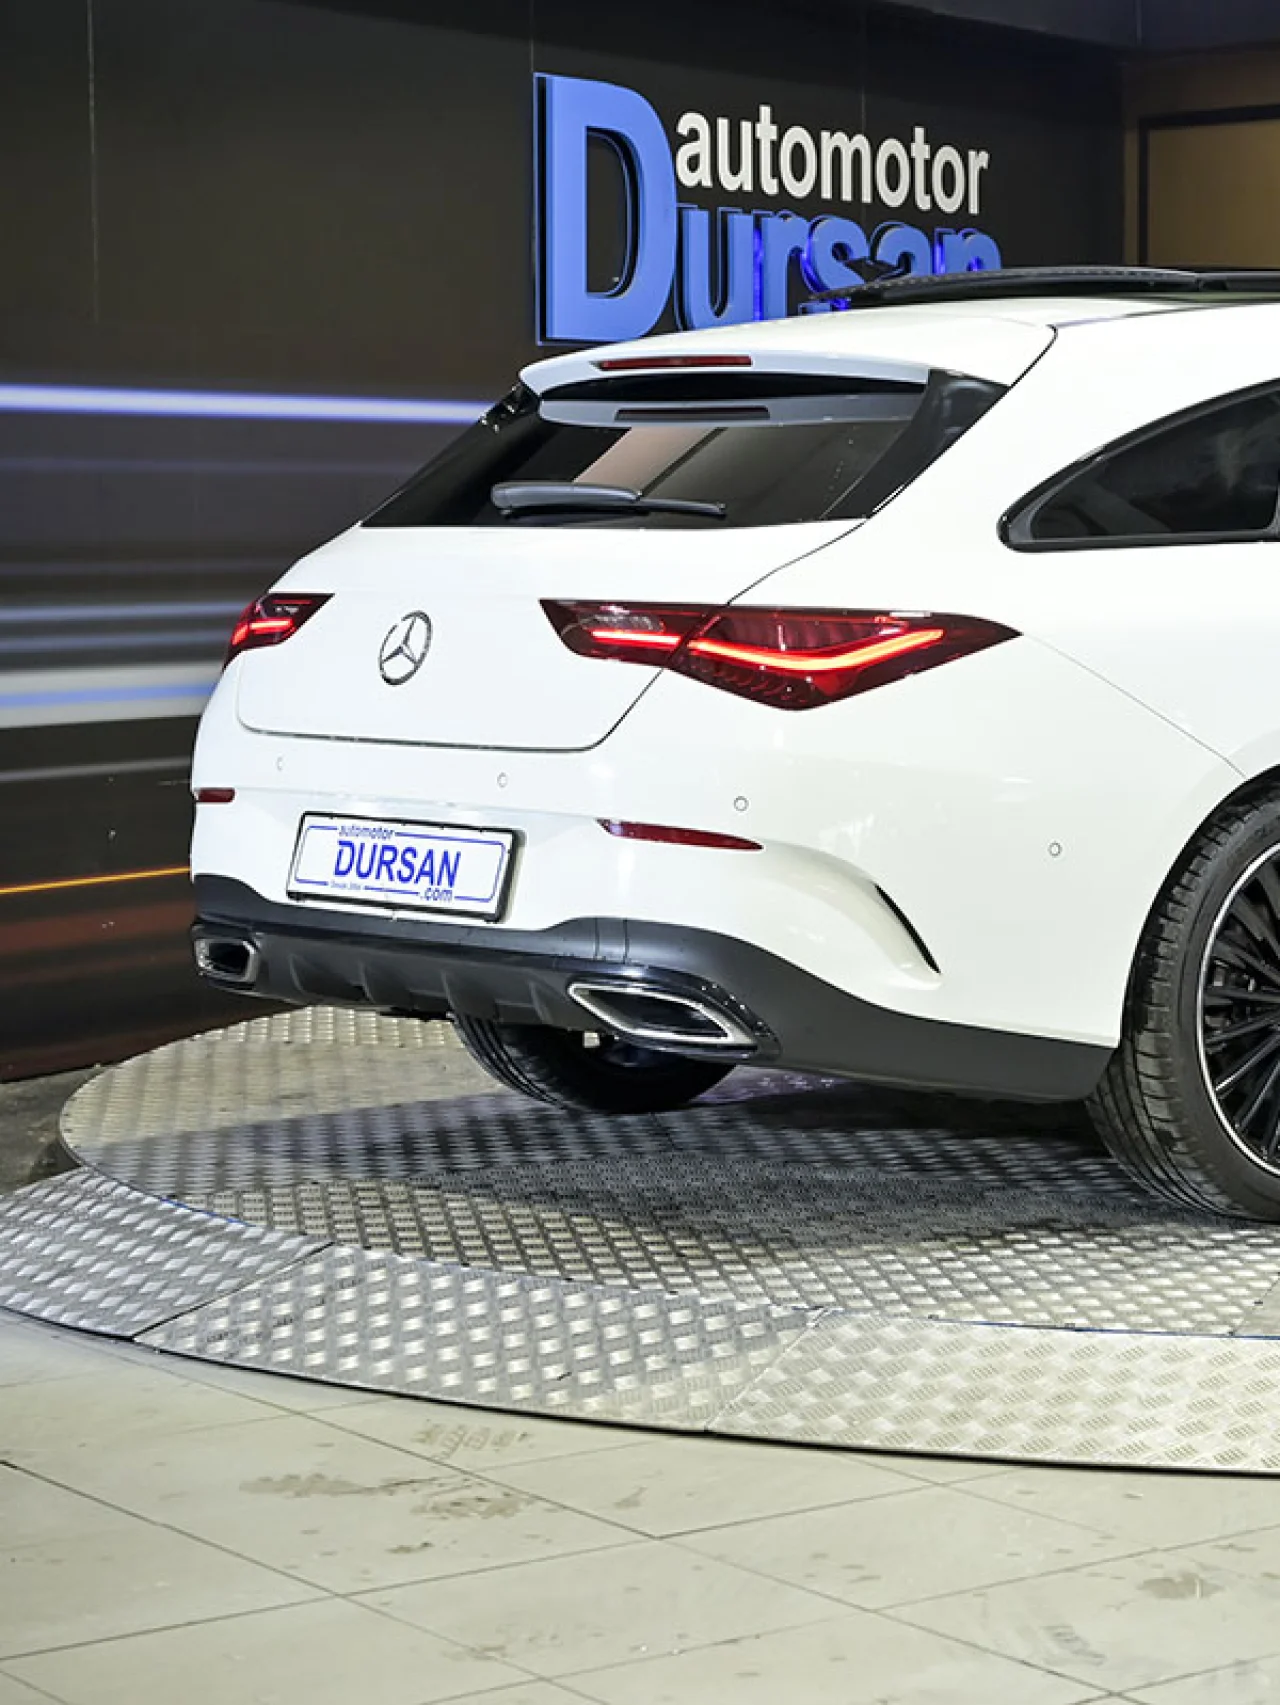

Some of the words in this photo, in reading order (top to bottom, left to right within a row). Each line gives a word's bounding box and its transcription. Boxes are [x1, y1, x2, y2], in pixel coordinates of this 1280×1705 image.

[675, 105, 990, 215] automotor
[338, 824, 395, 840] automotor
[334, 840, 462, 888] DURSAN
[419, 887, 454, 901] .com
